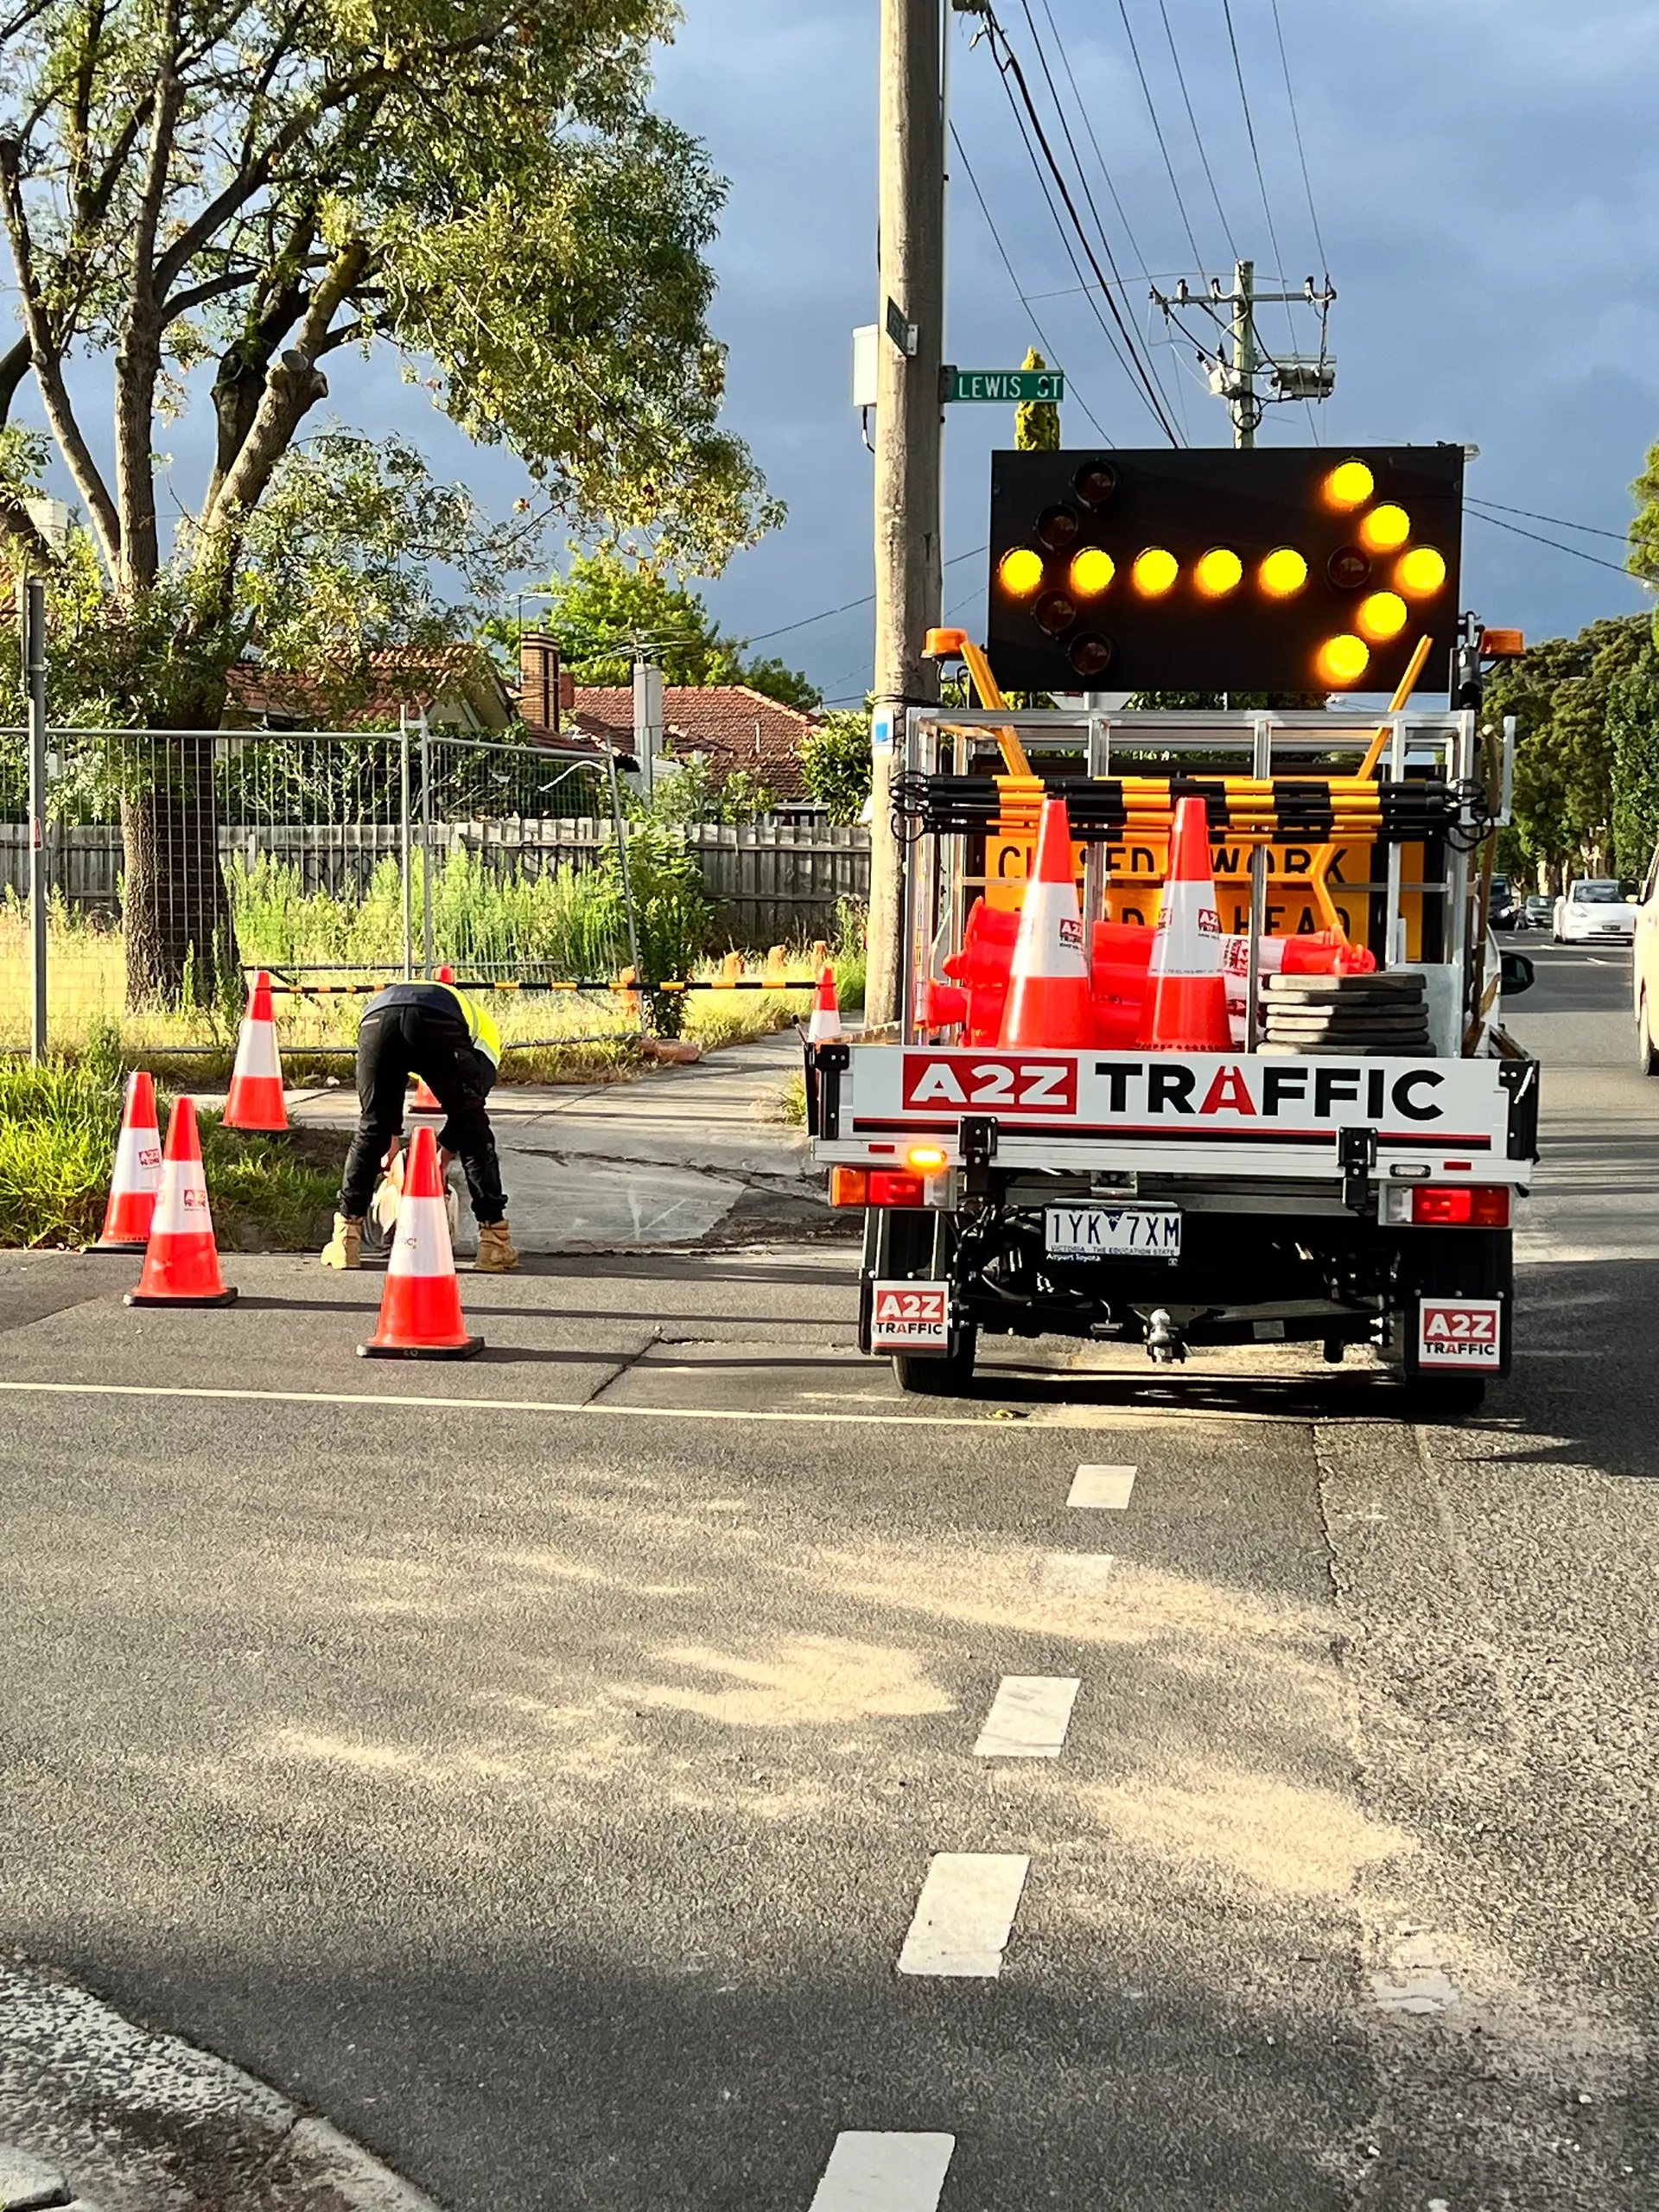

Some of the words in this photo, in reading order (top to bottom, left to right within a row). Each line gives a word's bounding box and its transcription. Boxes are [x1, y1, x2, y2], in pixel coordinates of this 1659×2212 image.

[958, 375, 1021, 398] LEWIS
[1037, 375, 1062, 397] ST
[1211, 848, 1348, 883] WORK
[1218, 906, 1351, 939] HEAD
[910, 1063, 1068, 1106] A2Z
[1095, 1062, 1446, 1121] TRAFFIC
[1053, 1213, 1101, 1245] 1YK
[1127, 1215, 1179, 1247] 7XM
[1046, 1253, 1074, 1262] Airport
[1051, 1244, 1085, 1253] VICTORIA
[878, 1294, 941, 1319] A2Z
[876, 1322, 943, 1335] TRAFFIC
[1427, 1313, 1492, 1338] A2Z
[1424, 1342, 1495, 1356] TRAFFIC
